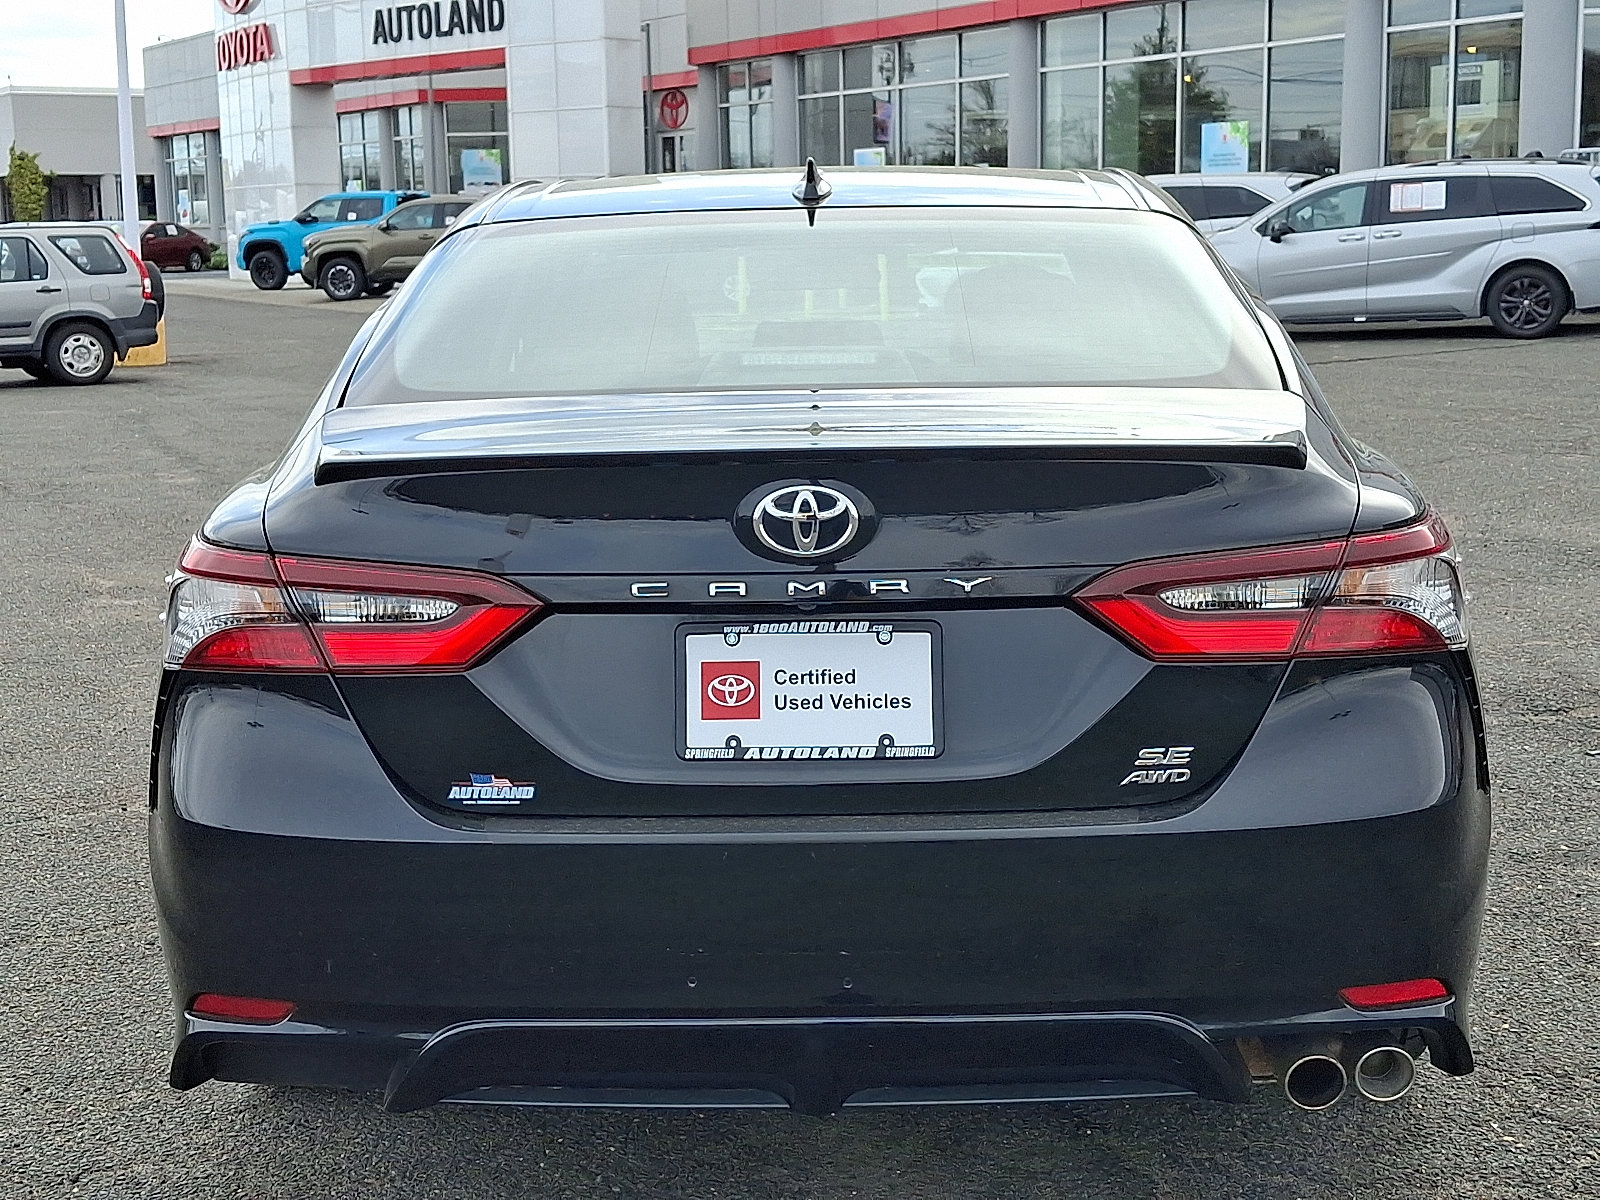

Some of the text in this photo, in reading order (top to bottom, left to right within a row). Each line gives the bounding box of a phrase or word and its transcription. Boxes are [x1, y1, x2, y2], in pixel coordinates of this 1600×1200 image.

[372, 0, 505, 44] AUTOLAND
[630, 576, 993, 597] CAMRY
[723, 621, 893, 633] www.1800AUTOLAND.com
[774, 669, 856, 685] Certified
[774, 693, 912, 710] Used Vehicles
[685, 747, 936, 759] SPRINGFIELD AUTOLAND SPRINGFIELD
[1134, 746, 1195, 766] SE
[1119, 768, 1191, 786] AWD
[447, 786, 535, 799] AUTOLAND
